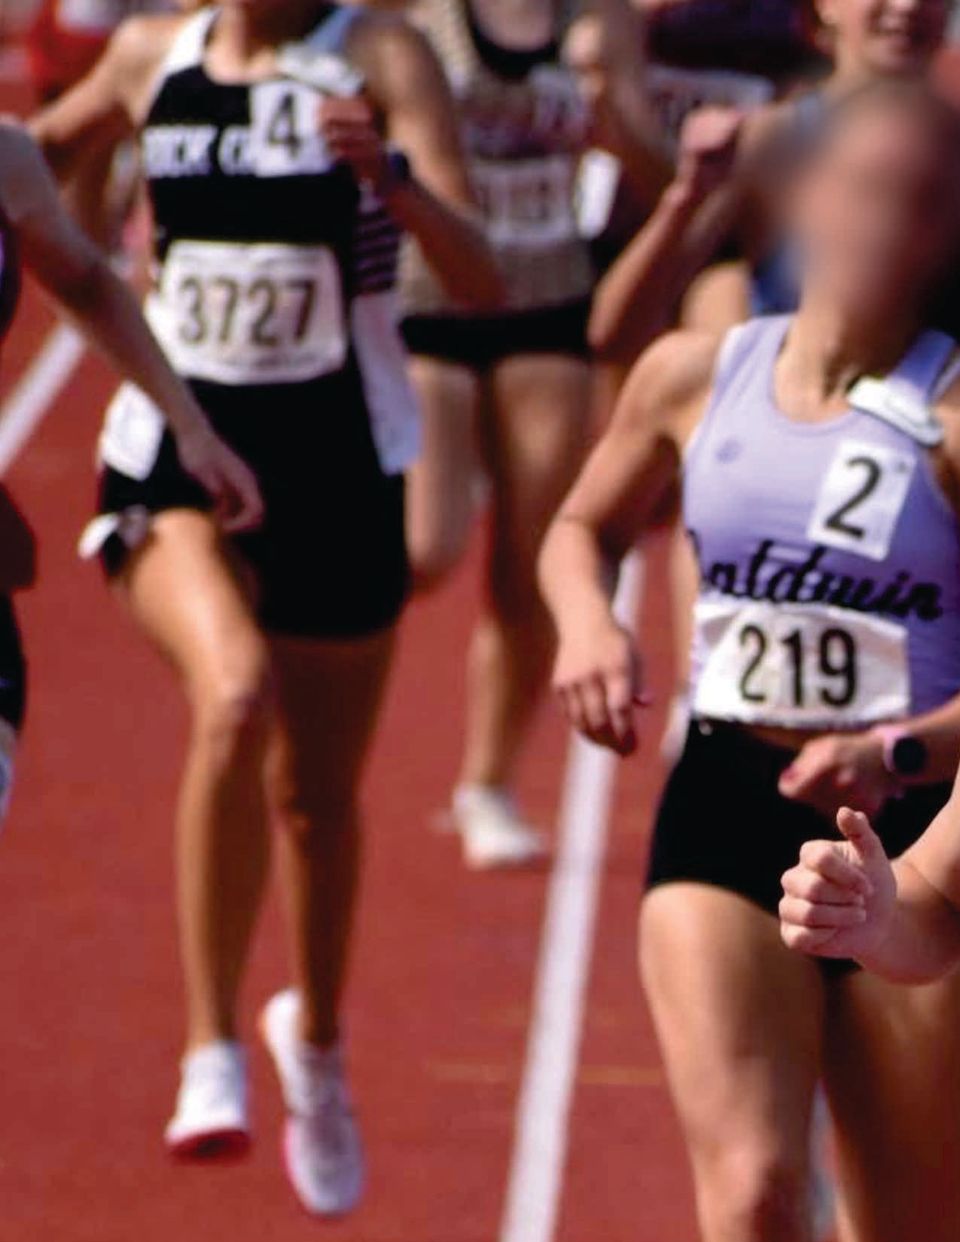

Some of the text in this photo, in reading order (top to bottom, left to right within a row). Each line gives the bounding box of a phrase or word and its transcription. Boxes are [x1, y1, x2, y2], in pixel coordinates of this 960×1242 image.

[266, 92, 303, 158] 4
[178, 275, 319, 345] 3727
[824, 454, 883, 540] 2
[690, 530, 943, 621] aldwin
[739, 624, 858, 709] 219
